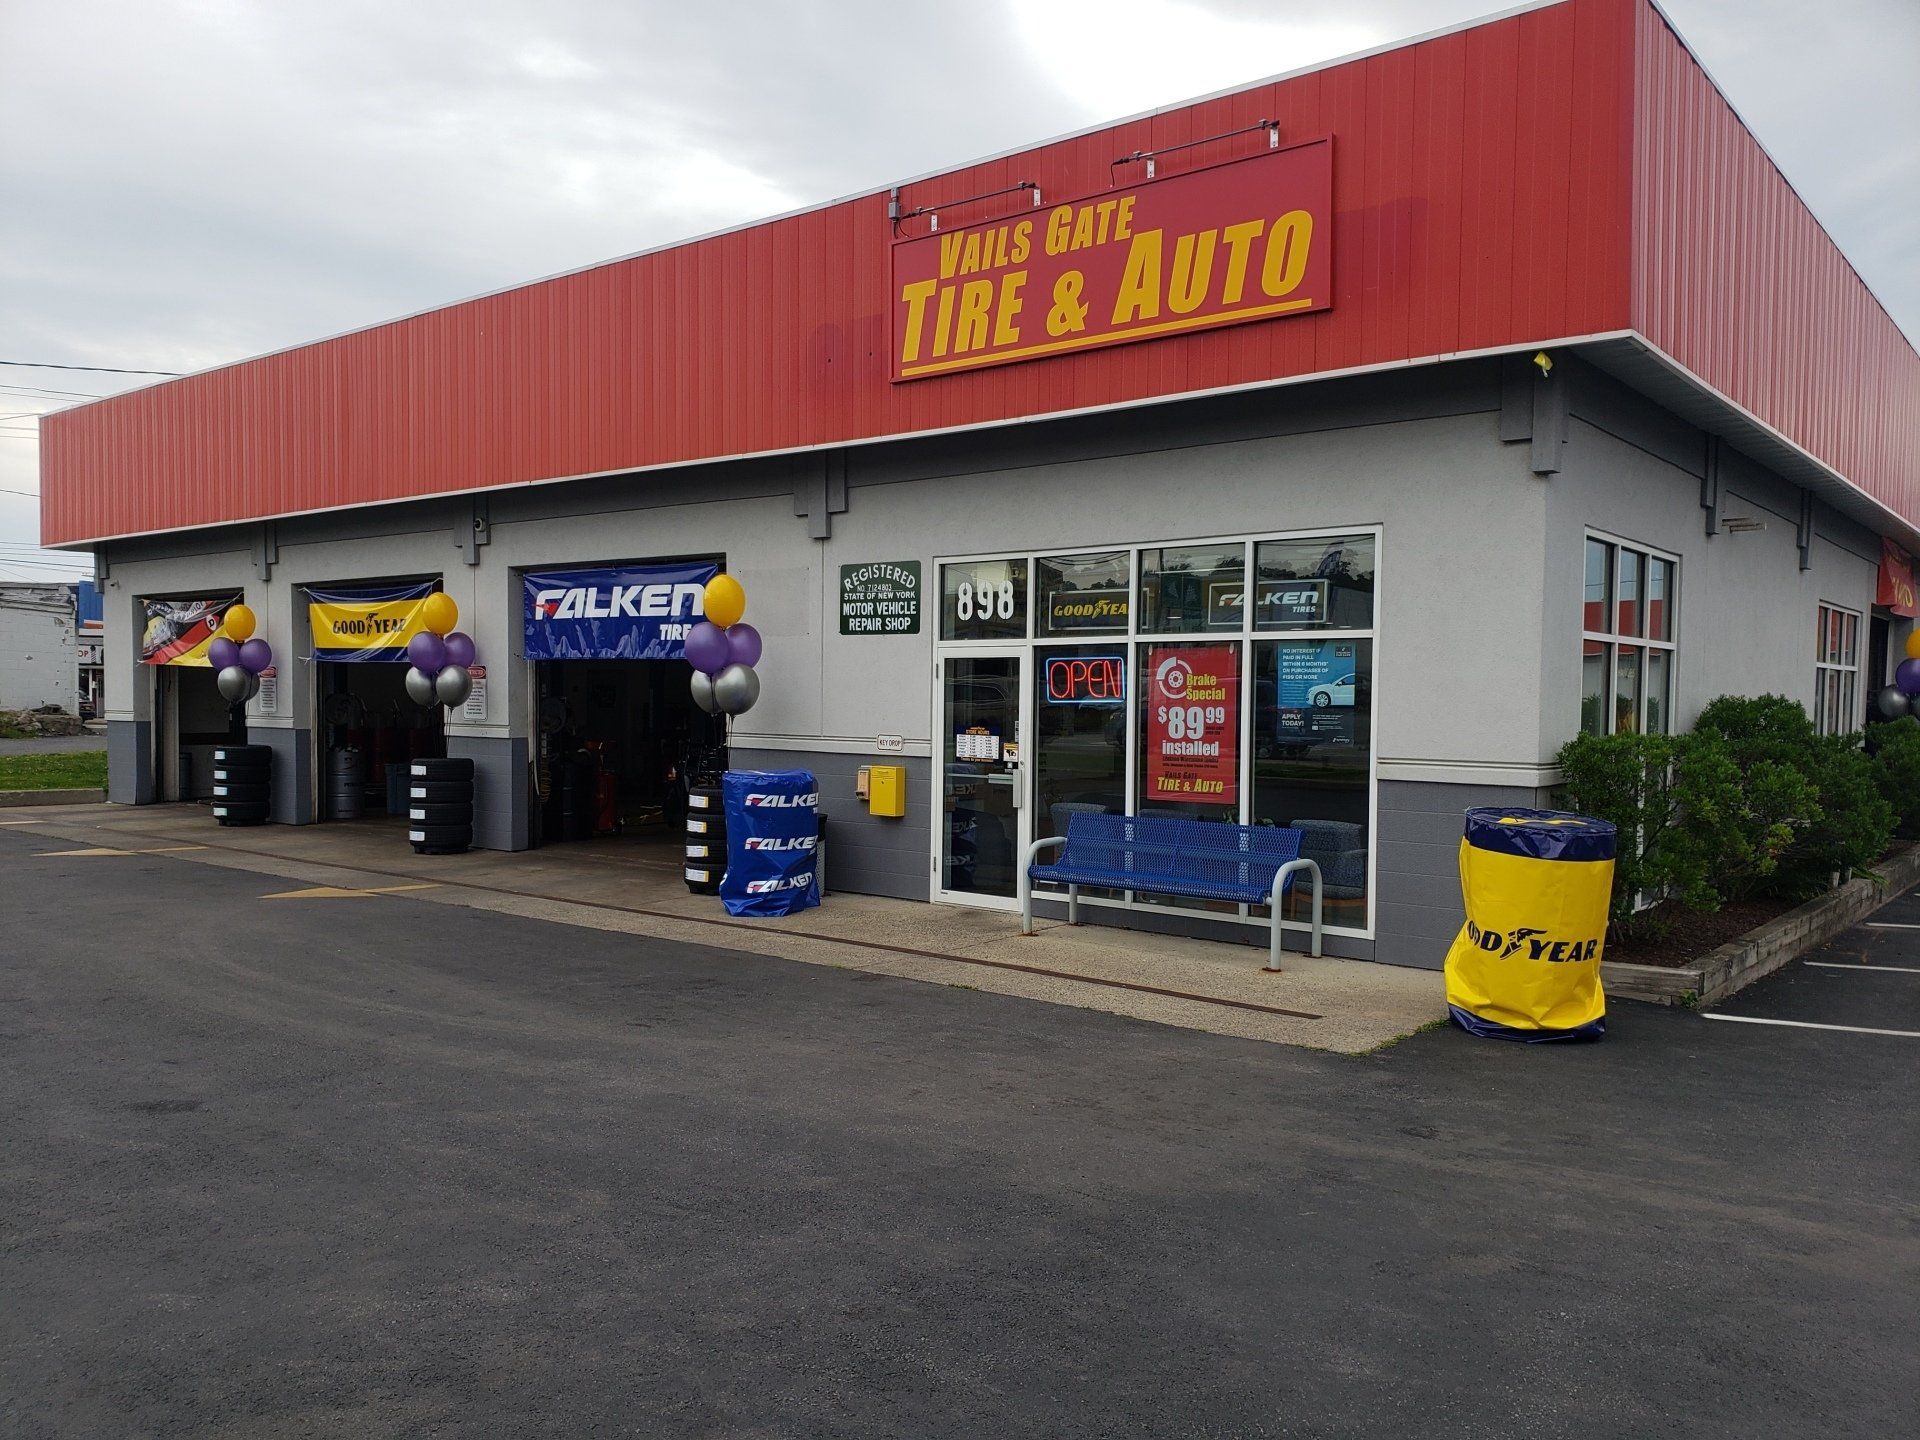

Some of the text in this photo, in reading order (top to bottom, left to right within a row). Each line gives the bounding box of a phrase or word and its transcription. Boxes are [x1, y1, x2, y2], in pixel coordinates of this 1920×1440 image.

[940, 195, 1136, 279] VAILS GATE
[902, 209, 1313, 362] TIRE & AUTO
[844, 564, 916, 591] REGISTERED
[534, 584, 705, 620] FALKEN
[958, 580, 1014, 621] 898
[1219, 591, 1319, 606] FAKEN
[843, 601, 916, 616] MOTOR VEHICLE
[1054, 600, 1129, 619] GOODYEA
[660, 624, 692, 640] TIRE
[849, 617, 911, 631] REPAIR SHOP
[1050, 660, 1121, 699] OPEN
[1186, 673, 1217, 686] Brake
[1186, 688, 1225, 701] Special
[1162, 740, 1219, 756] installed
[1158, 776, 1224, 793] TIRE & AUTO
[744, 835, 818, 850] FALKE
[746, 872, 813, 893] FALKEN
[1467, 920, 1598, 962] OODYEAR
